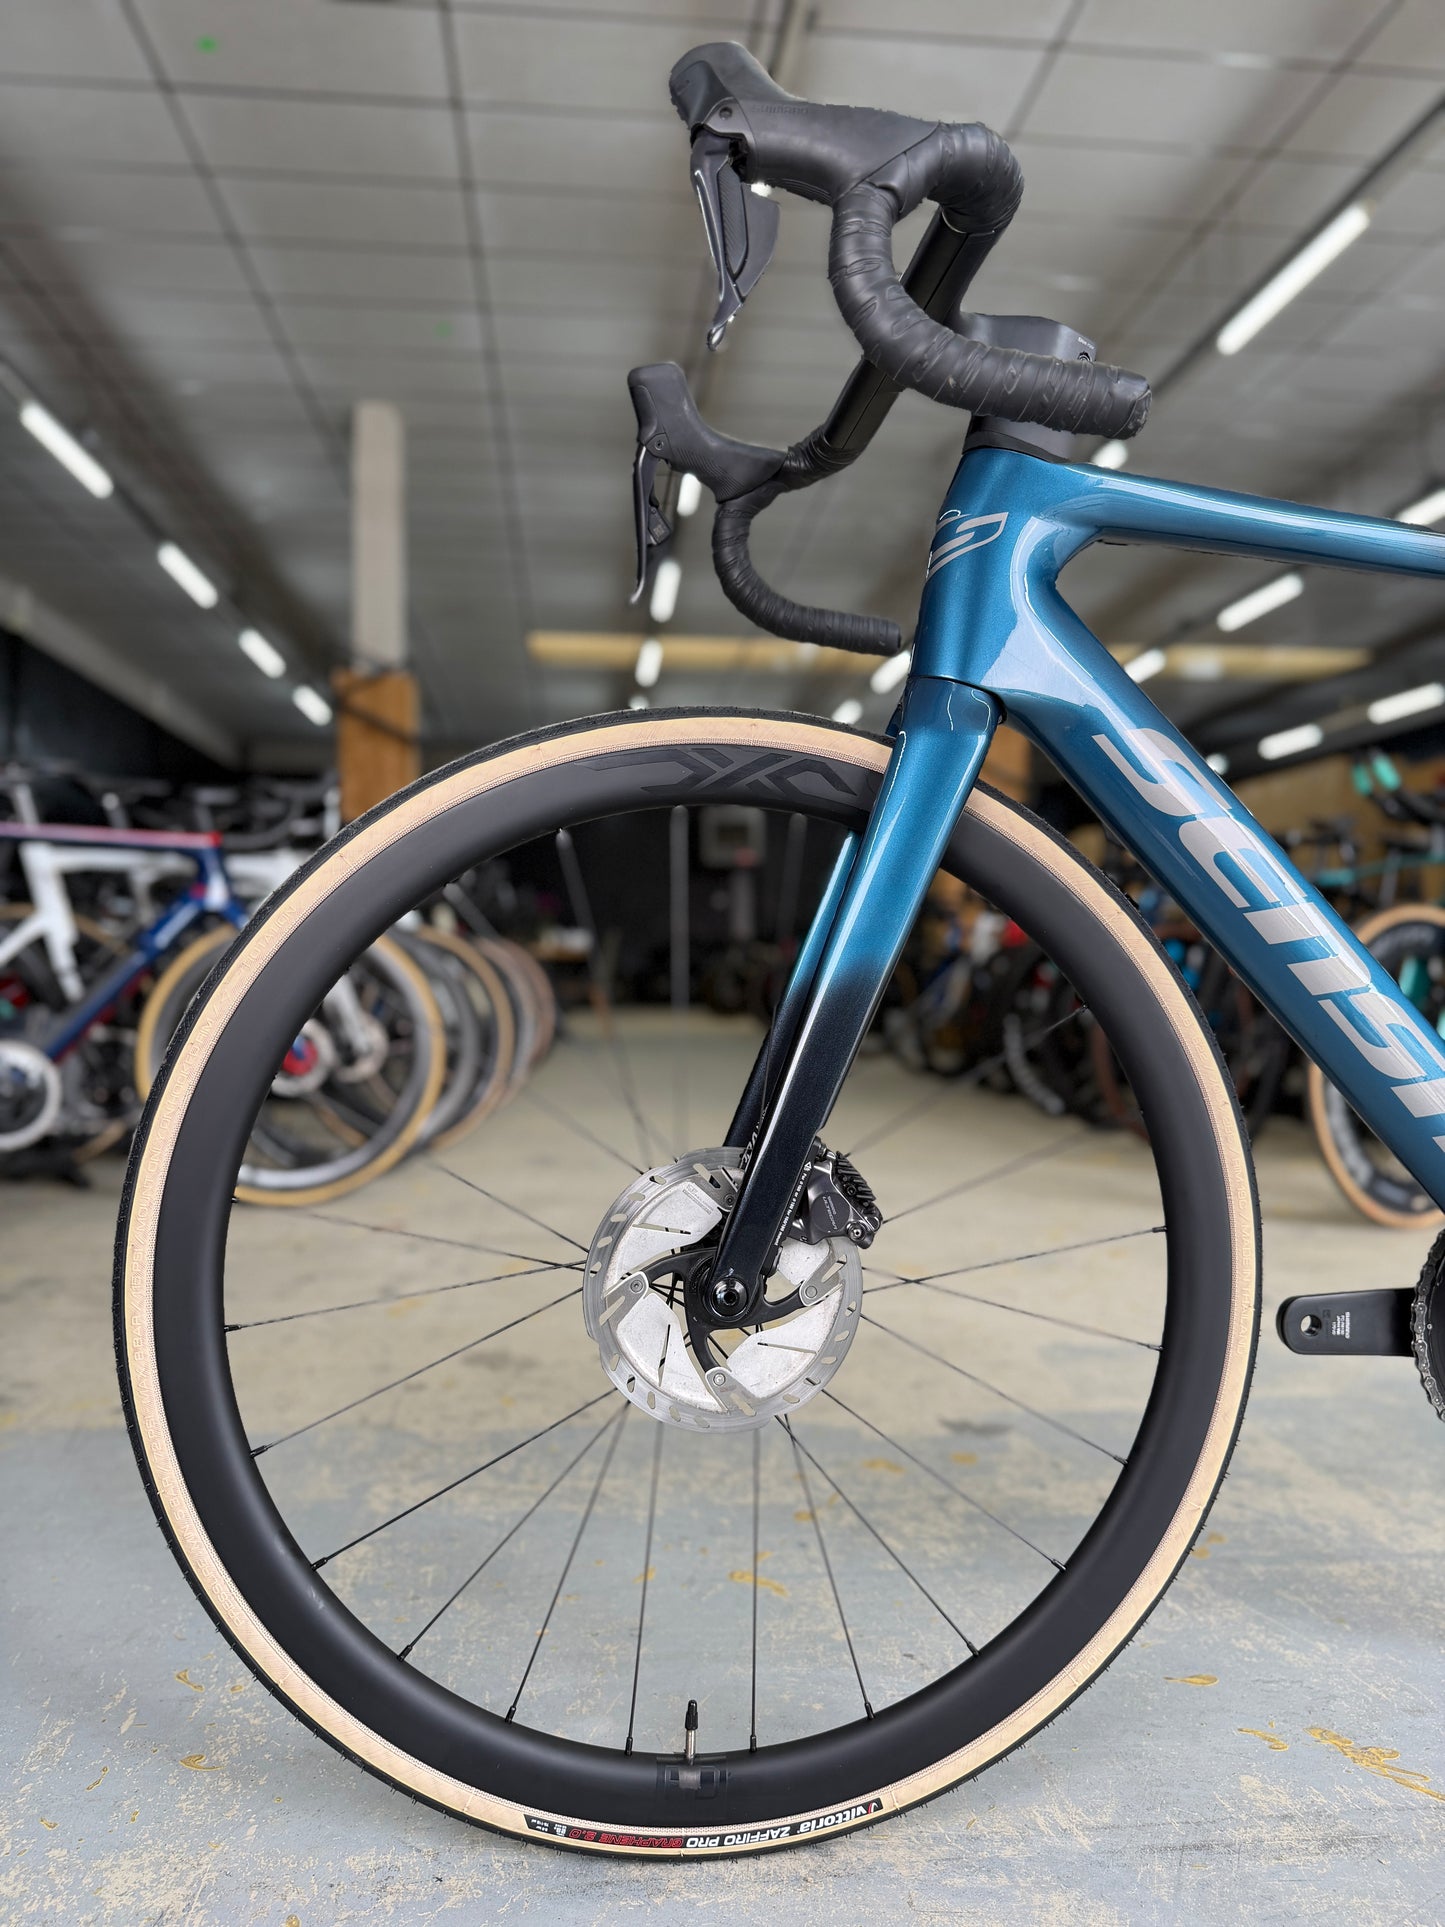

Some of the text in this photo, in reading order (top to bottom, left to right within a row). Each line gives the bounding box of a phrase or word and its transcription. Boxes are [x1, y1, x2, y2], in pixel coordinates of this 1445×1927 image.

[799, 1805, 867, 1833] vittoria
[568, 1828, 597, 1841] 2.0
[599, 1833, 683, 1848] GRAPHENE
[686, 1836, 720, 1848] PRO
[724, 1825, 790, 1845] ZAFFIRO
